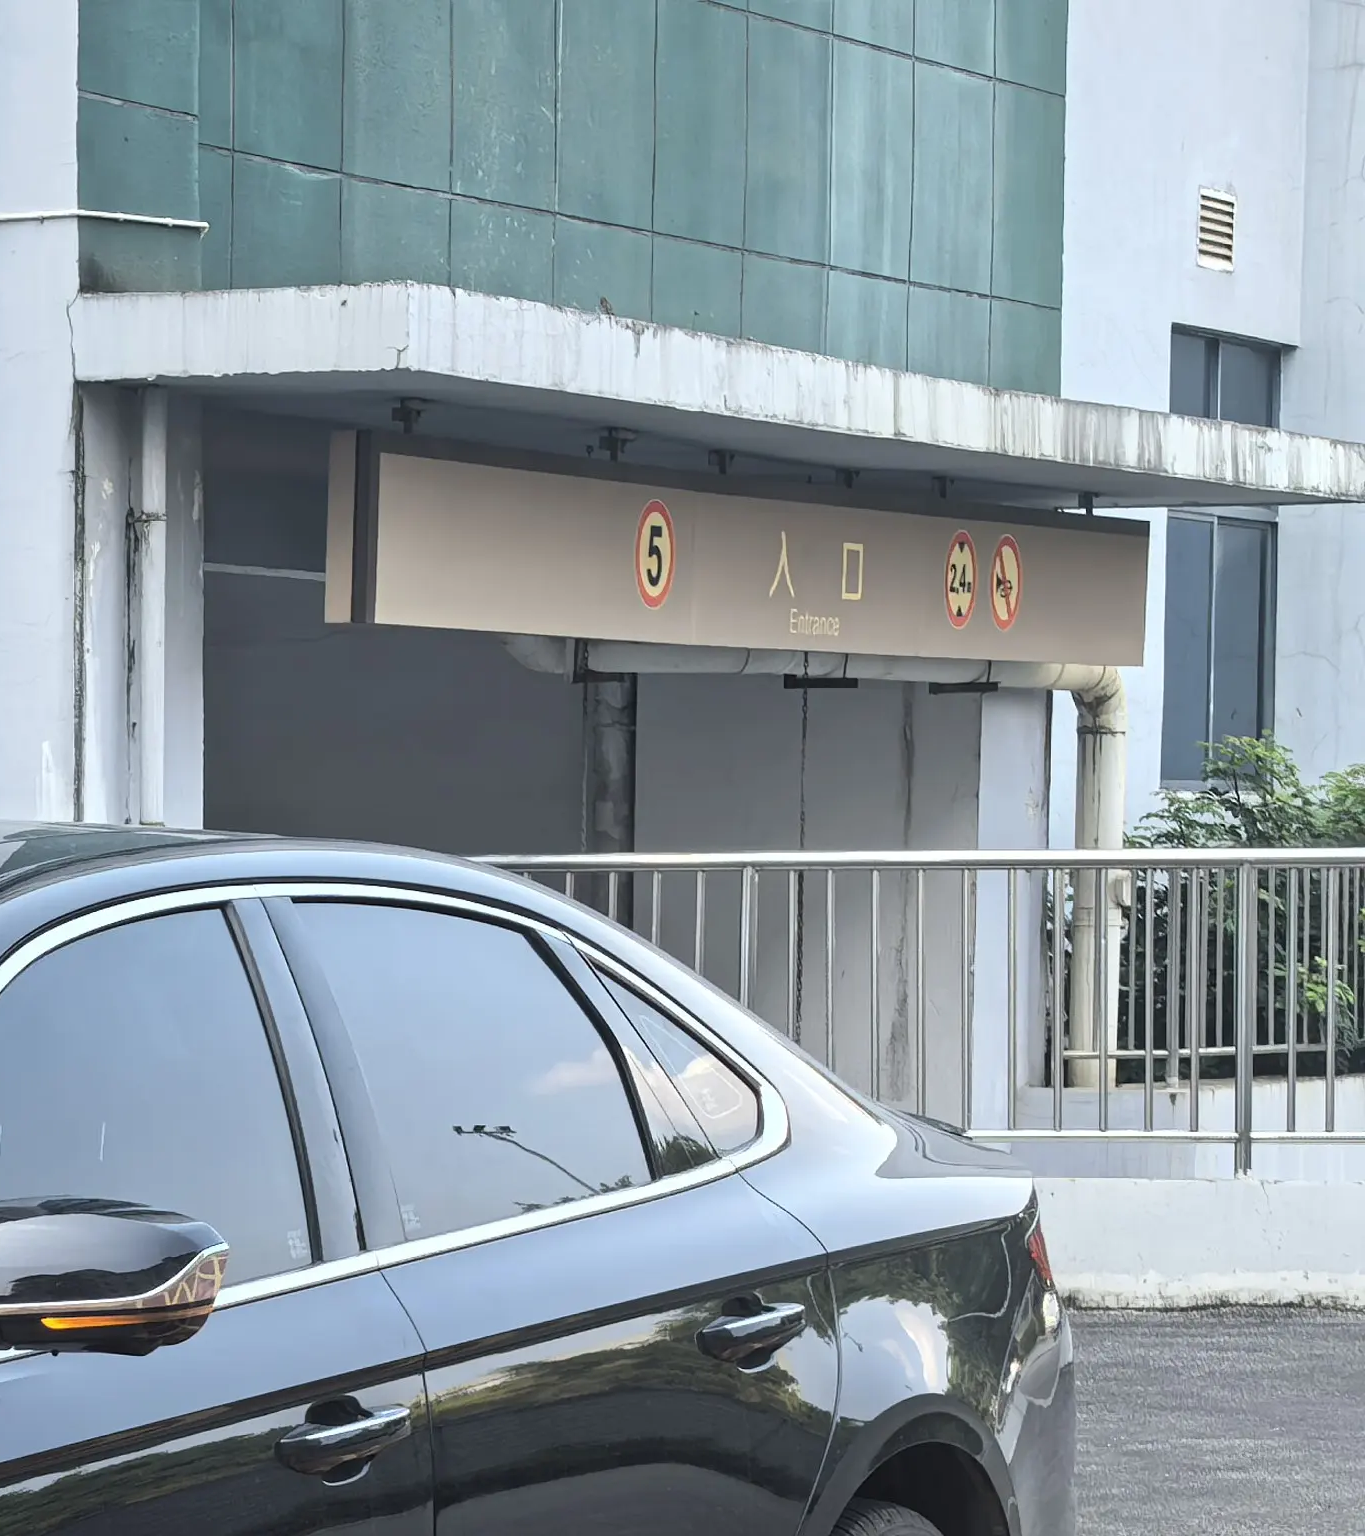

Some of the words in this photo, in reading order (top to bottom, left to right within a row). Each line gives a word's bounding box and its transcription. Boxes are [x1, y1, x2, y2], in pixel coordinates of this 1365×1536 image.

[647, 525, 662, 586] 5
[768, 531, 863, 600] 入口
[789, 608, 840, 636] Entrance
